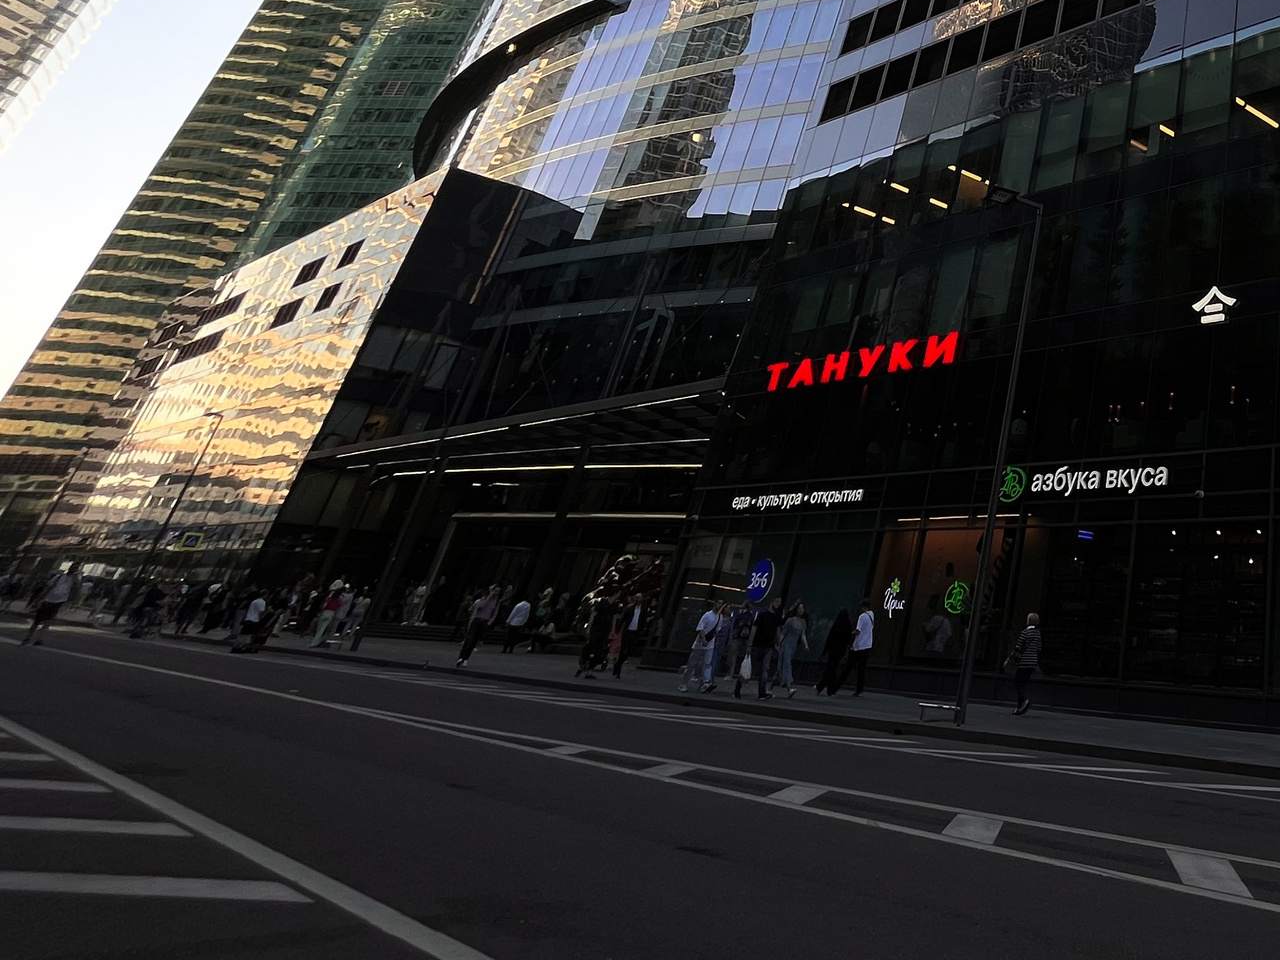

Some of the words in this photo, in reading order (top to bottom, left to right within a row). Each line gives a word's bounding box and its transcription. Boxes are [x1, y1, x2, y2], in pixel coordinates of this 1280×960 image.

[767, 331, 959, 391] ТАНУКИ
[1031, 465, 1101, 497] азбука
[1105, 466, 1169, 494] вкуса
[731, 496, 751, 510] еда
[756, 492, 803, 511] культура
[809, 488, 864, 507] открытия
